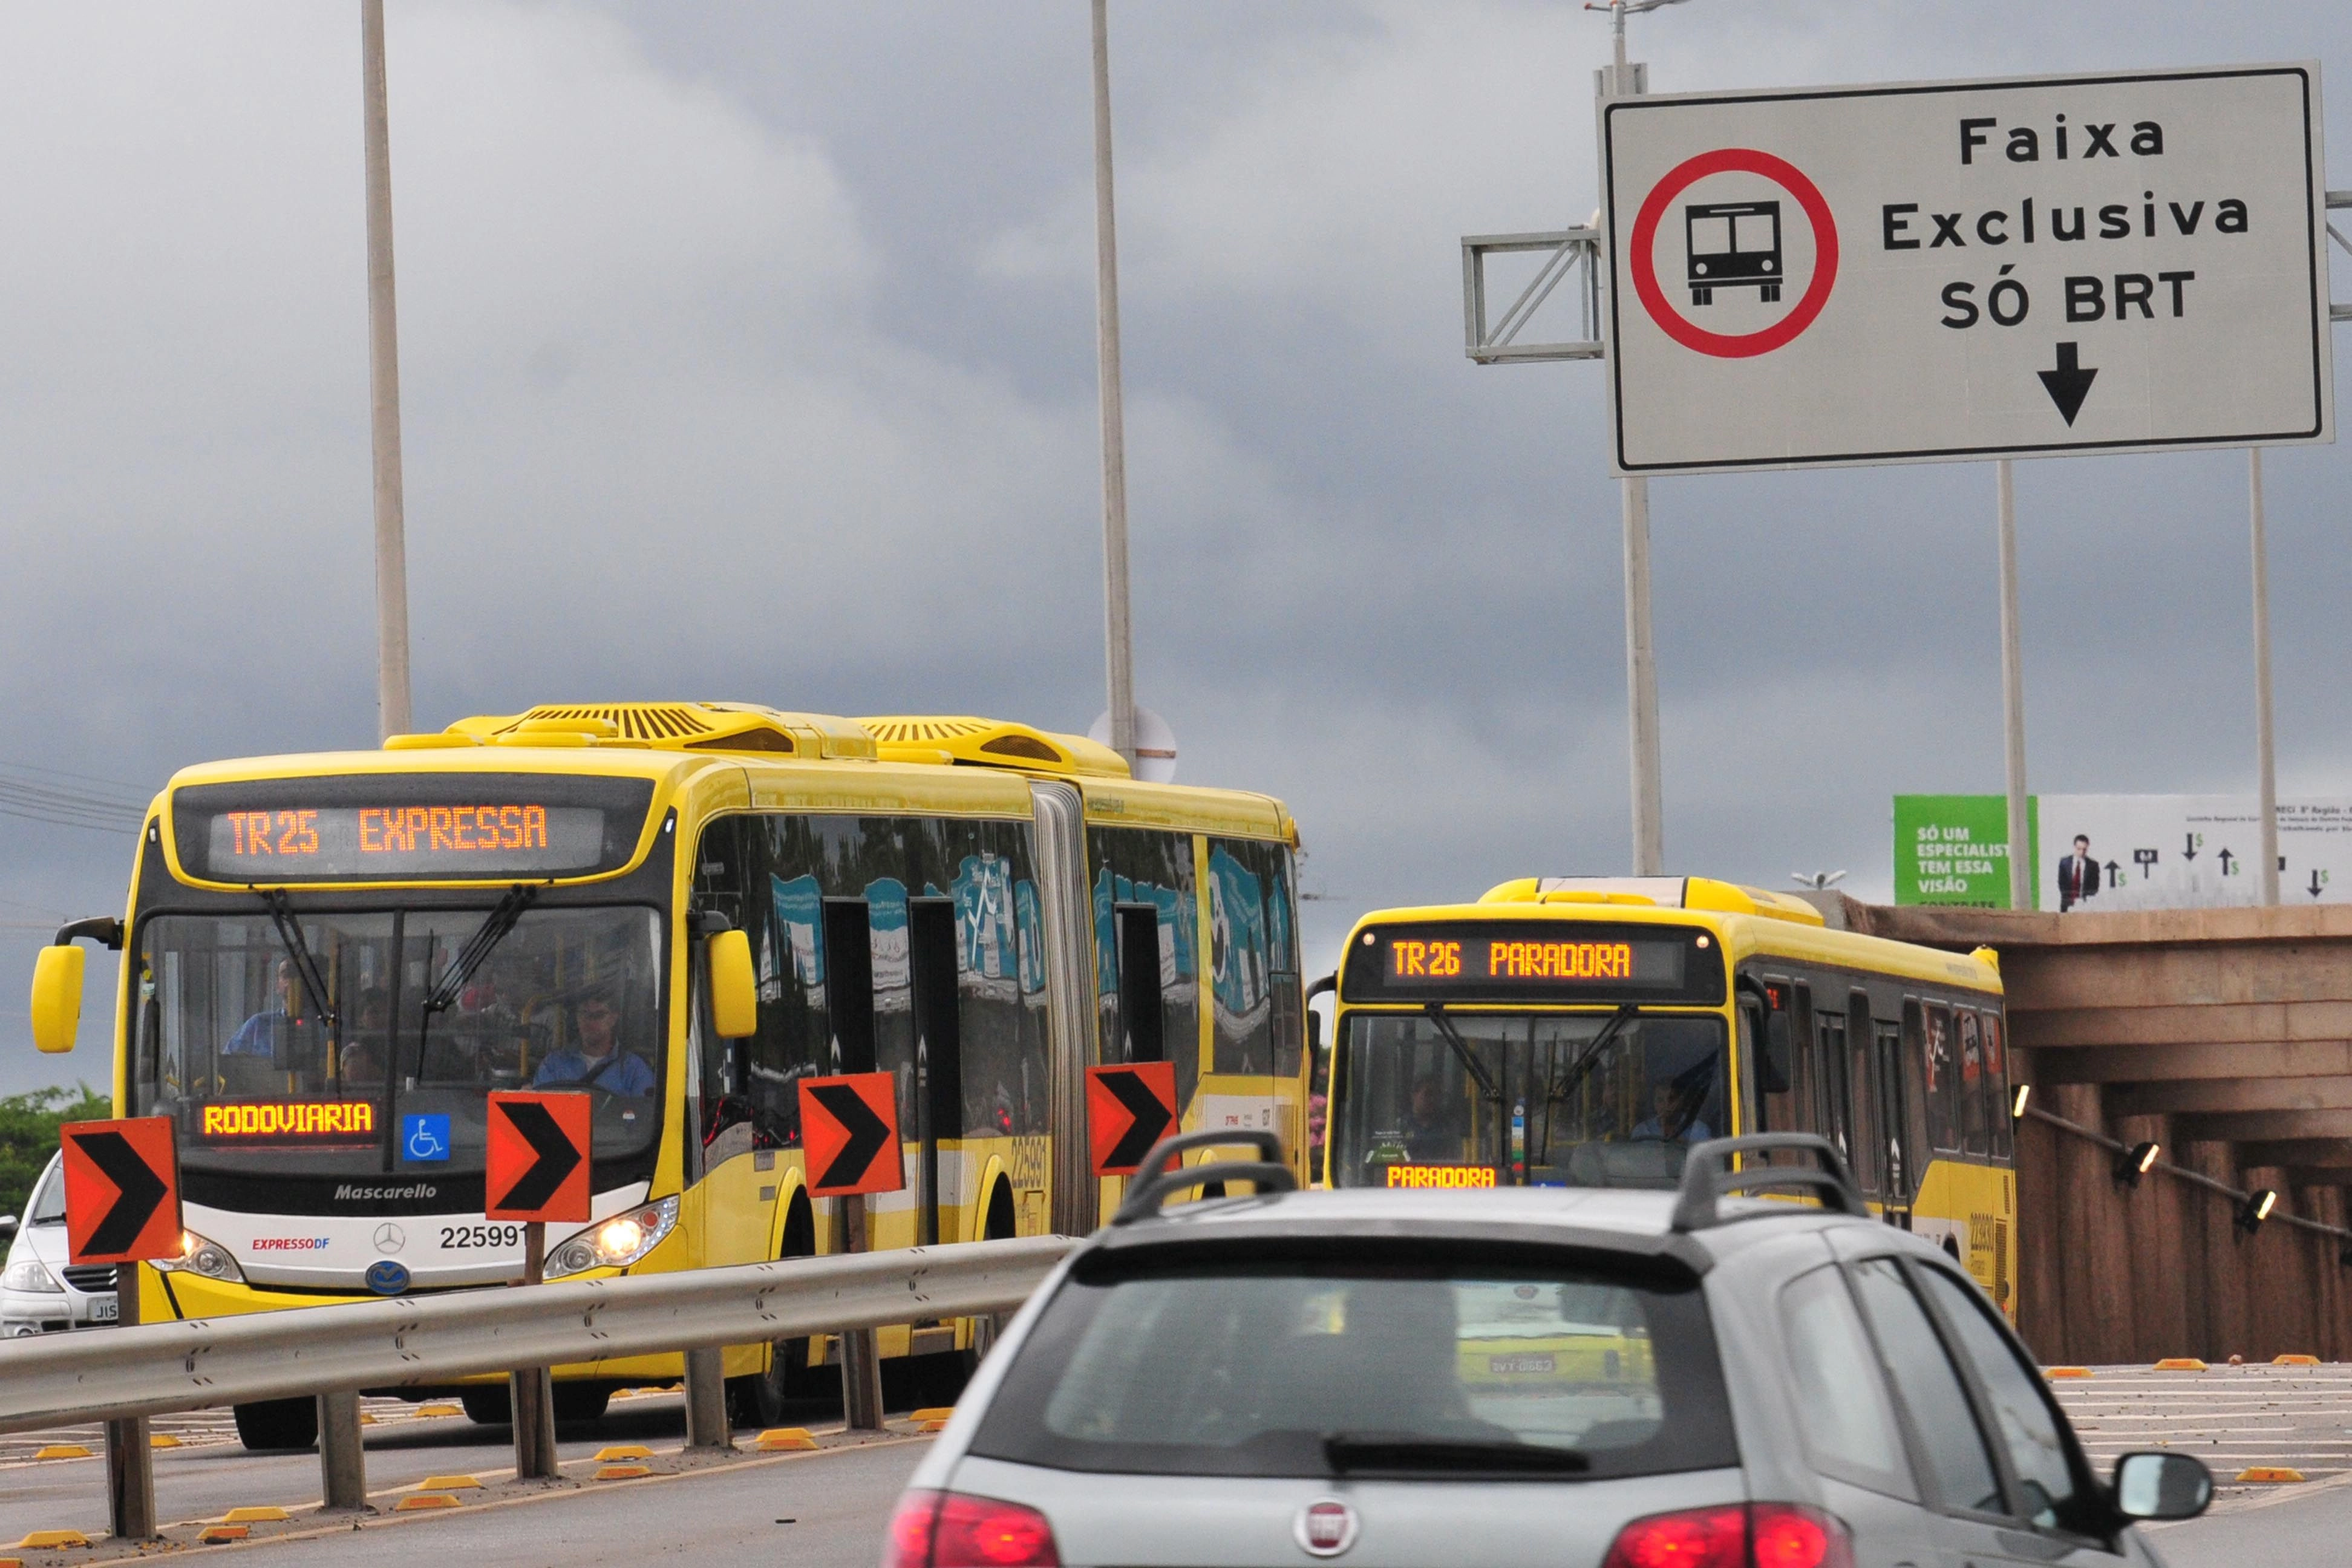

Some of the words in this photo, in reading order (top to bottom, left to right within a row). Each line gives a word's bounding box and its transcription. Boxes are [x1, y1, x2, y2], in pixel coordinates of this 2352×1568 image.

[1959, 113, 2164, 165] Faixa
[1882, 190, 2249, 250] Exclusiva
[1941, 264, 2030, 330] SÓ
[2064, 270, 2195, 323] BRT
[359, 805, 547, 852] EXPRESSA
[1917, 824, 1939, 841] SÓ
[1942, 827, 1970, 841] UM
[1917, 844, 2010, 858] ESPECIALIST
[1918, 860, 1952, 875] TEM
[1955, 860, 1994, 875] ESSA
[1918, 875, 1968, 893] VISÃO
[1490, 942, 1630, 978] PARADORA
[204, 1103, 372, 1135] RODOVIARIA
[1005, 1136, 1046, 1188] 225991
[1387, 1166, 1495, 1188] PARADORA
[334, 1183, 437, 1200] Mascarello
[252, 1238, 330, 1250] EXPRESSODF
[96, 1305, 117, 1318] JIS
